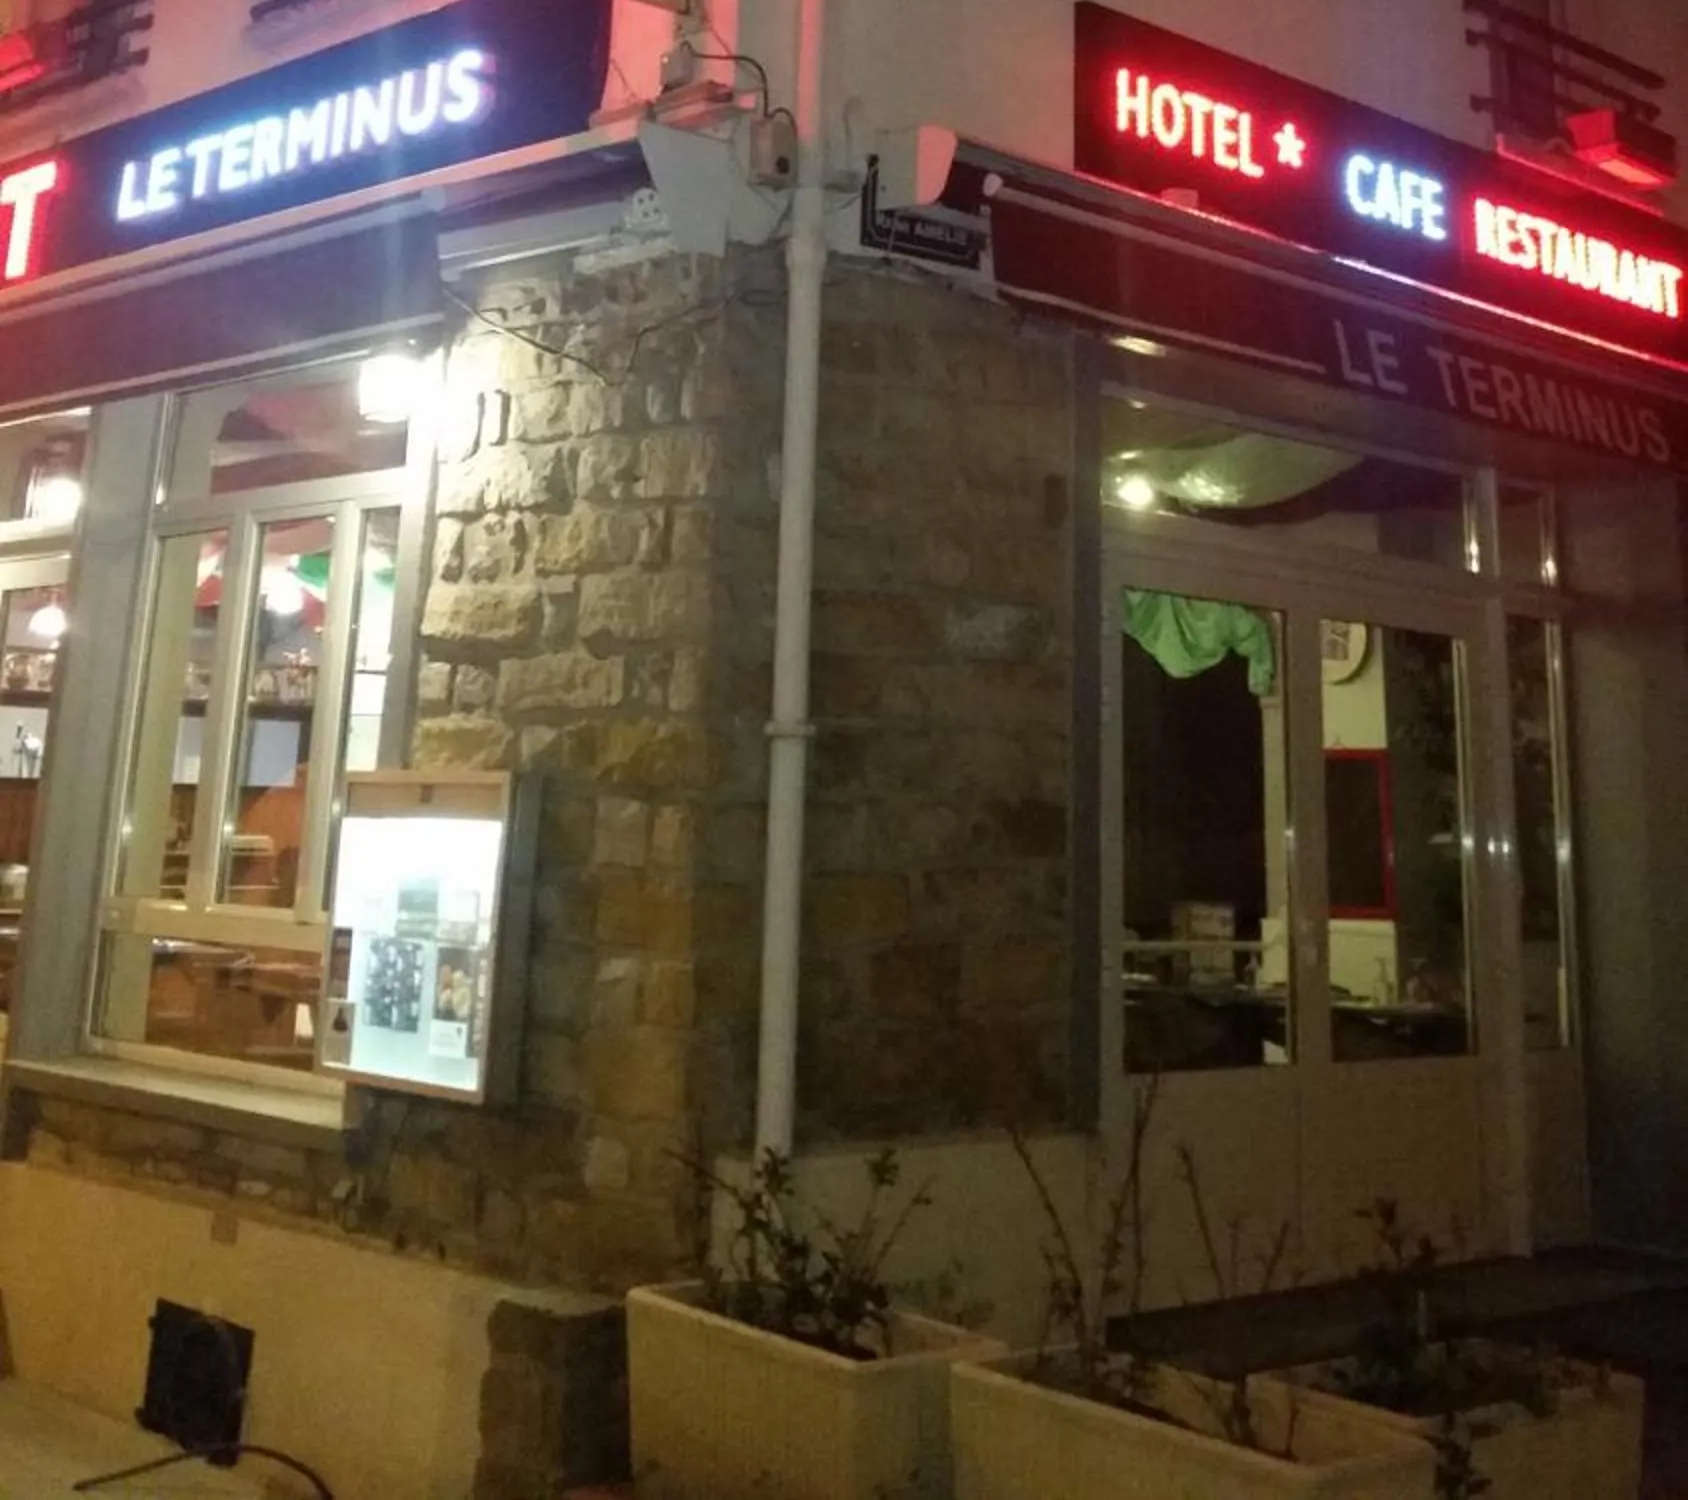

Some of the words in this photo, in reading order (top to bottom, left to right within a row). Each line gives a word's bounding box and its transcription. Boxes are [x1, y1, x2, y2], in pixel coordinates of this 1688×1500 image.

[116, 149, 181, 221] LE
[189, 49, 484, 199] TERMINUS
[1115, 67, 1264, 179] HOTEL
[1344, 154, 1448, 241] CAFE
[1474, 197, 1684, 318] RESTAURANT
[1333, 318, 1409, 394] LE
[1426, 345, 1672, 463] TERMINUS
